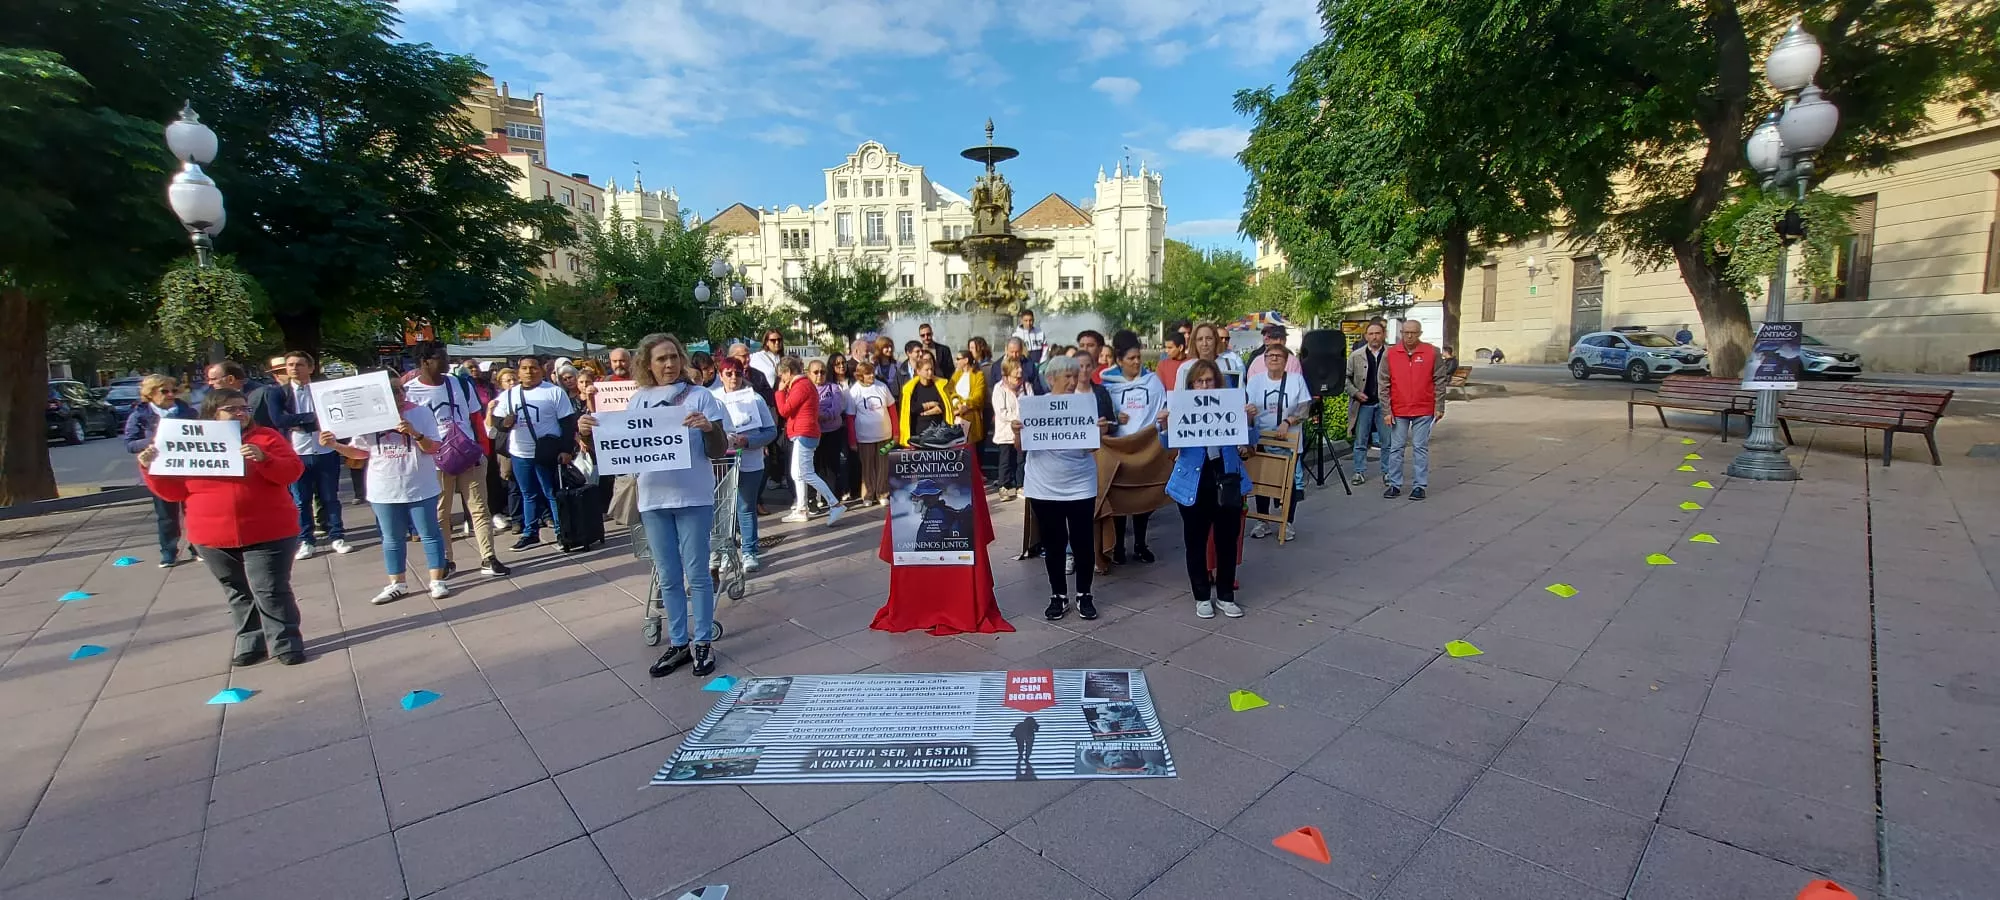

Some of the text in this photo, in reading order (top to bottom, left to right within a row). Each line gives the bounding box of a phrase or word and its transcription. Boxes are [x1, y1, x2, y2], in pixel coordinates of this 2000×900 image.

[1050, 400, 1068, 410] SIN
[1194, 396, 1220, 407] SIN
[628, 418, 653, 430] SIN
[1024, 416, 1095, 426] COBERTURA
[1178, 412, 1237, 425] APOYO
[182, 424, 204, 436] SIN
[1177, 428, 1240, 438] SIN HOGAR
[1033, 432, 1086, 440] SIN HOGAR
[166, 441, 227, 452] PAPELES
[600, 434, 683, 450] RECURSOS
[612, 452, 676, 465] SIN HOGAR
[901, 450, 956, 462] EL CAMINO
[165, 458, 230, 468] SIN HOGAR
[896, 462, 964, 474] DE SANTIAGO
[942, 541, 968, 550] JUNTOS
[816, 750, 865, 758] VOLVER
[880, 749, 909, 758] SER,
[914, 748, 922, 756] A
[926, 748, 968, 756] ESTAR
[809, 758, 972, 768] A CONTAR, A PARTICIPAR
